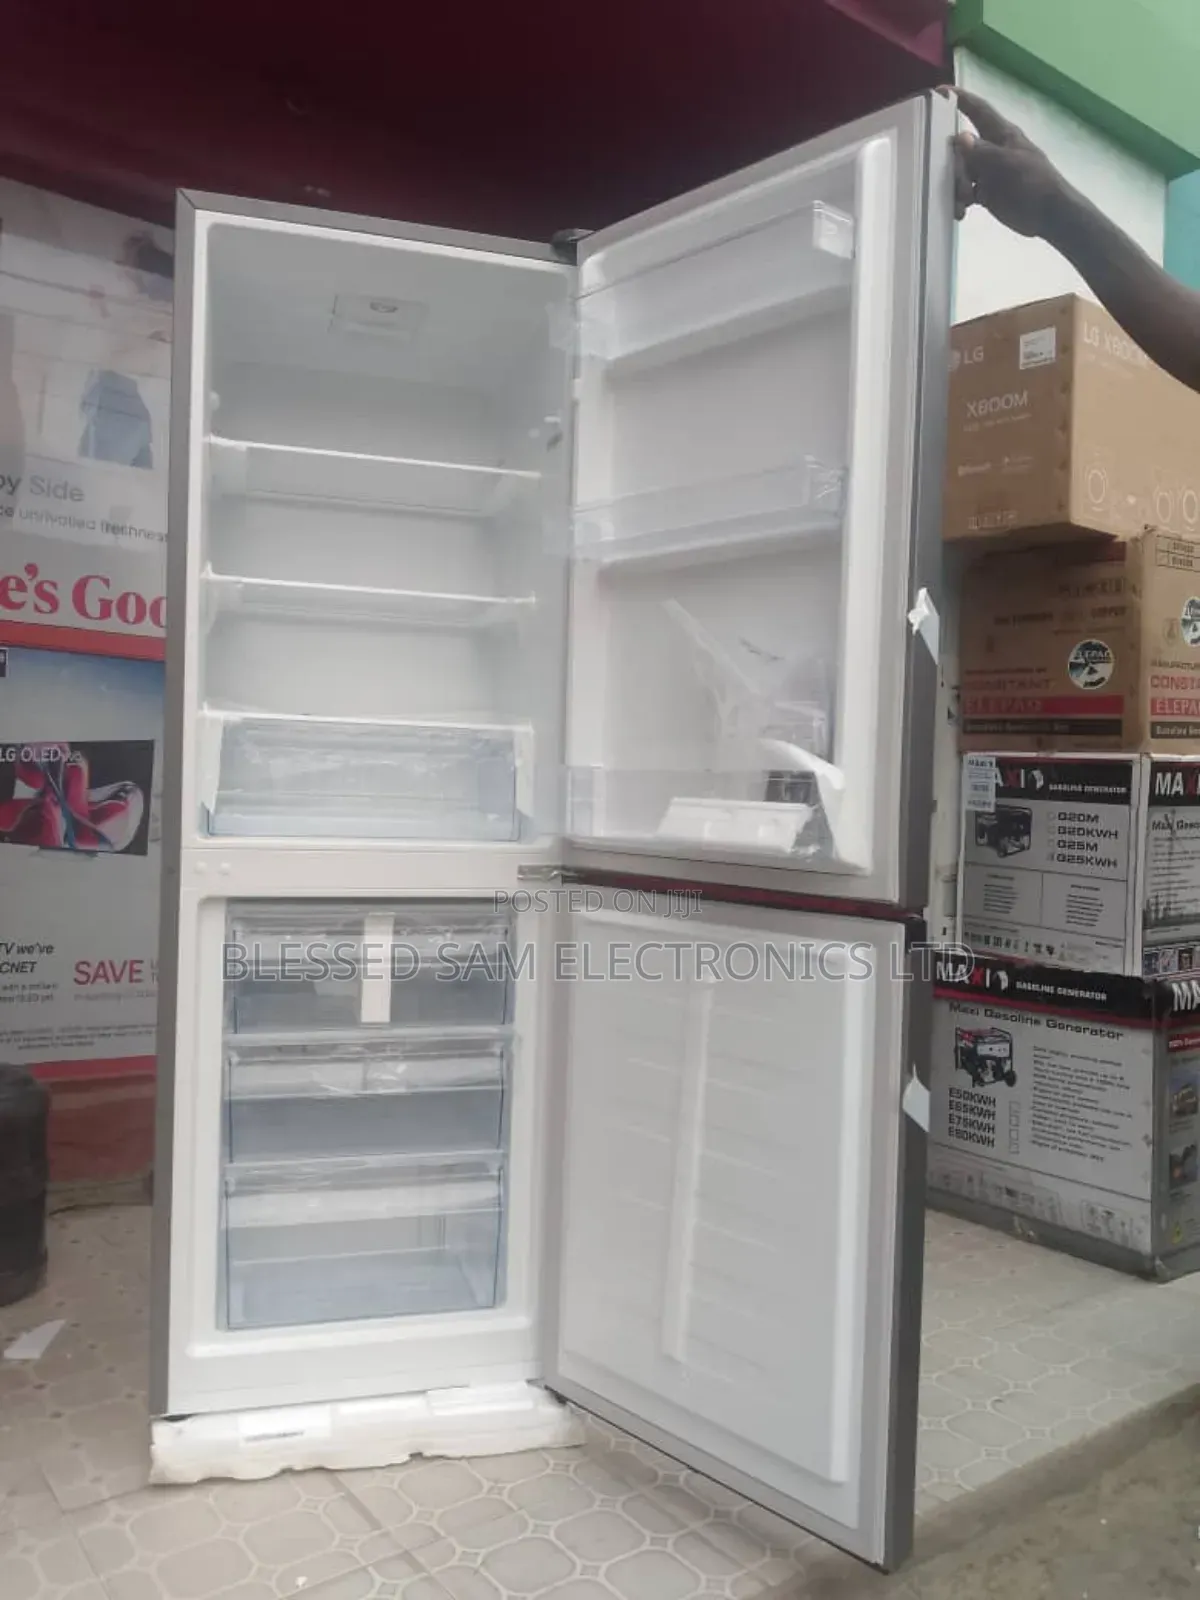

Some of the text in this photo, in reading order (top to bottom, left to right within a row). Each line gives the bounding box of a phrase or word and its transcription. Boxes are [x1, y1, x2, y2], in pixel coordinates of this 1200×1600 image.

[963, 346, 984, 364] LG
[30, 475, 85, 502] Side
[21, 747, 61, 764] OLED
[0, 961, 37, 975] CNET
[73, 959, 145, 985] SAVE
[1016, 981, 1108, 1001] GASOLINE GENERATOR
[984, 1008, 1042, 1027] Gasoline
[1046, 1018, 1124, 1041] Generator
